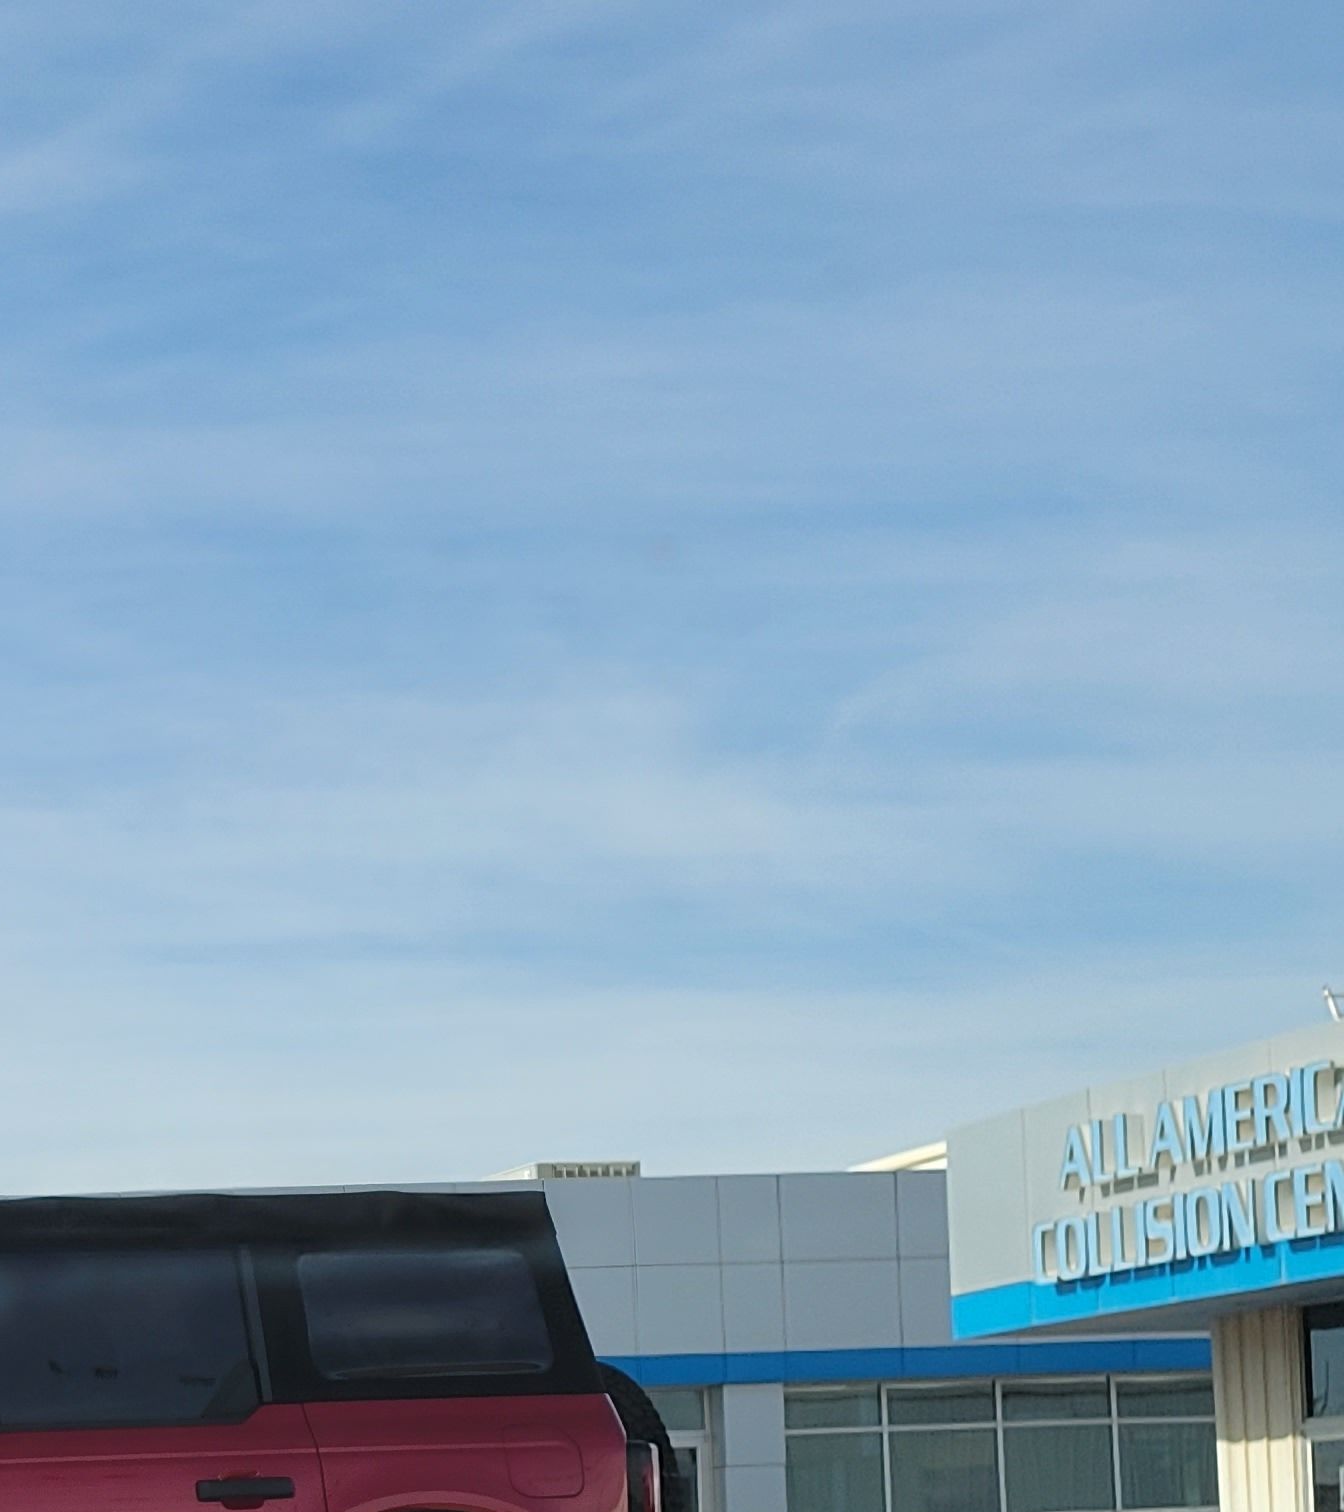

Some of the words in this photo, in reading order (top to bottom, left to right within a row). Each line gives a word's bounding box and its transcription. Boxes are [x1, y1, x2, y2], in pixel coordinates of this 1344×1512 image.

[1059, 1112, 1141, 1190] ALL
[1150, 1059, 1344, 1168] AMERIC
[1032, 1178, 1255, 1286] COLLISION
